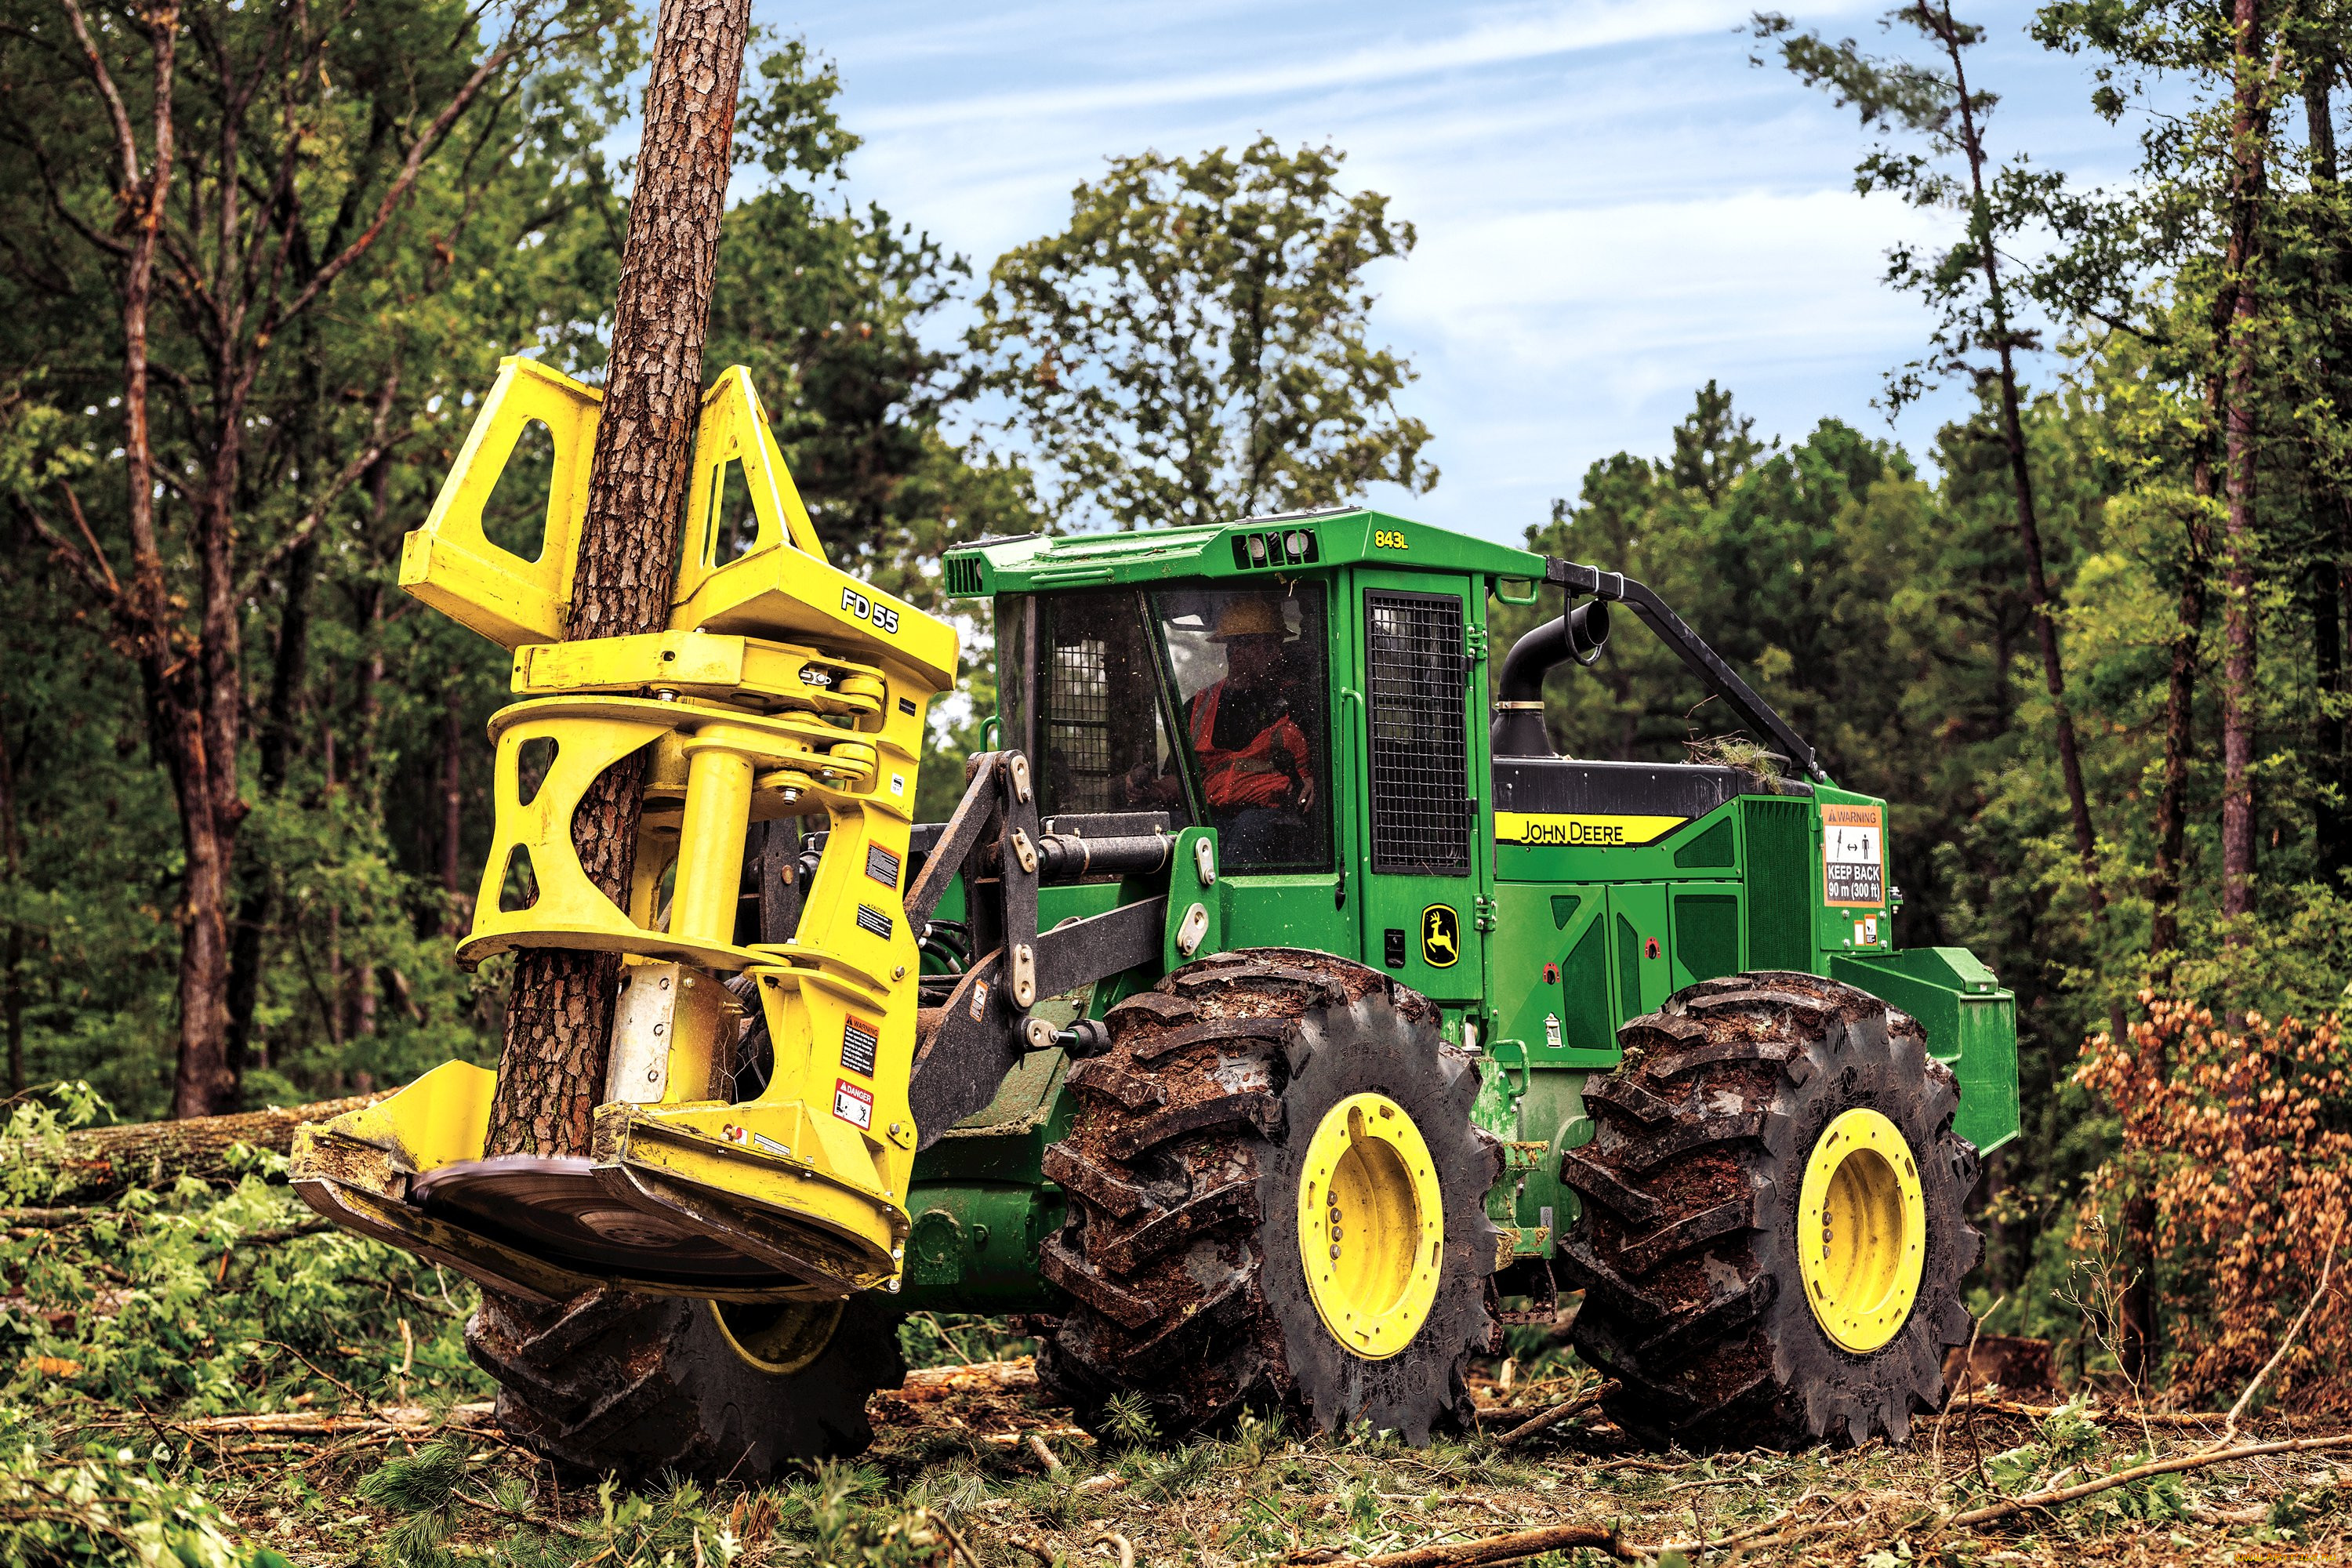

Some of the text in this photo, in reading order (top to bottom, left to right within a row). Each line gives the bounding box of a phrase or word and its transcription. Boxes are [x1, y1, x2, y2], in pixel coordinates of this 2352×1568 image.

[1374, 528, 1409, 550] 843L
[841, 586, 899, 634] FD 55
[1837, 811, 1876, 823] WARNING
[1521, 820, 1624, 842] JOHN DEERE
[1828, 865, 1880, 880] KEEP BACK
[1828, 882, 1880, 901] 90 m (300 ft)
[854, 1020, 878, 1036] WARNING
[847, 1086, 871, 1103] DANGER
